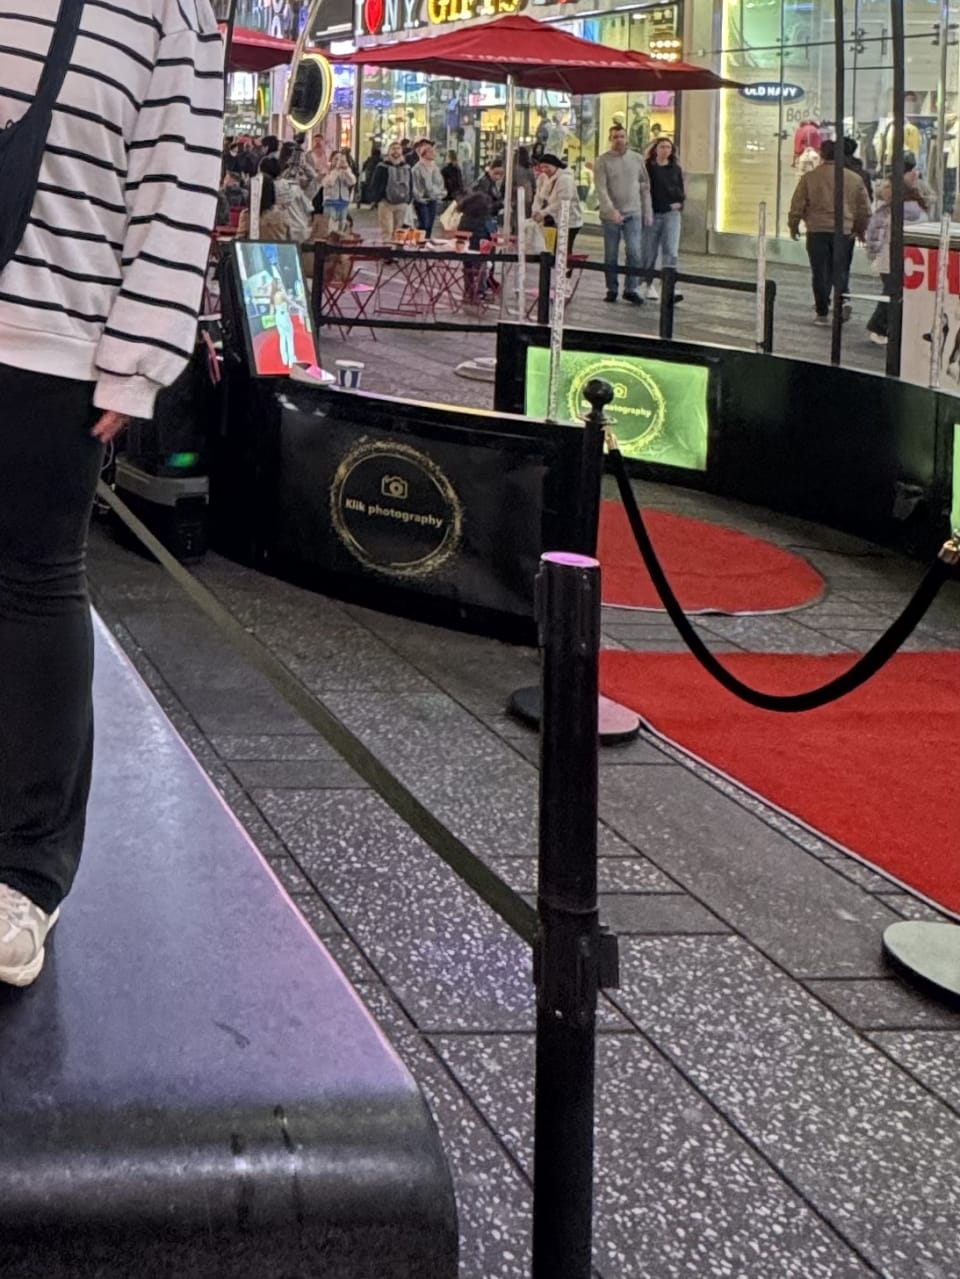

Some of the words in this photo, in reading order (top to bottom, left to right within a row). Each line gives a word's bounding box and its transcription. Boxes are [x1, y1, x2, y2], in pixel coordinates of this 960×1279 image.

[767, 86, 798, 97] NAVY
[345, 498, 366, 513] Klik
[368, 504, 443, 528] photography
